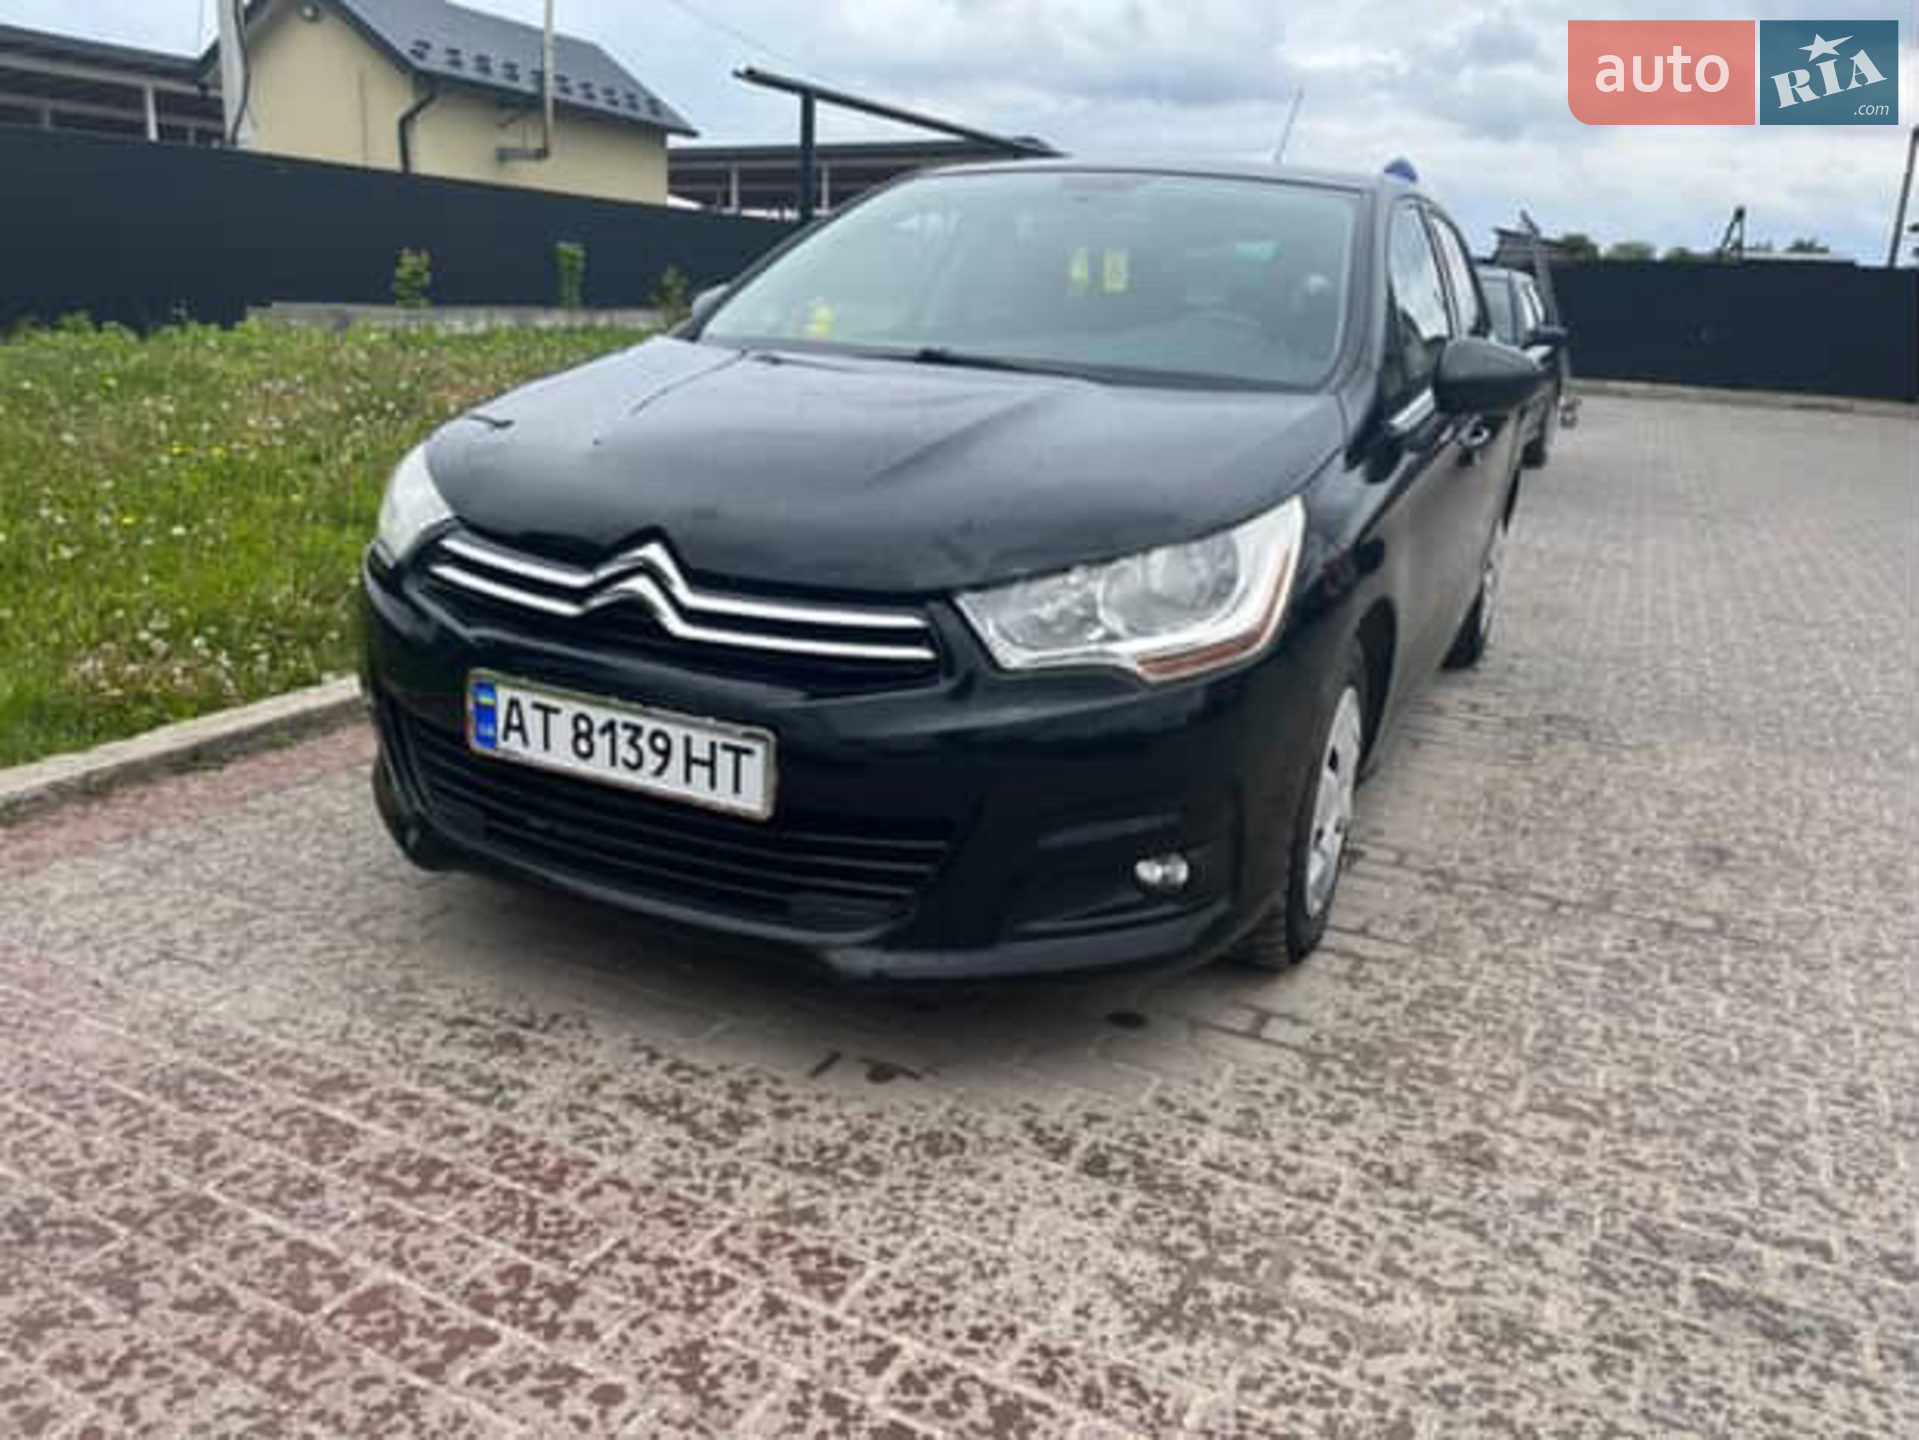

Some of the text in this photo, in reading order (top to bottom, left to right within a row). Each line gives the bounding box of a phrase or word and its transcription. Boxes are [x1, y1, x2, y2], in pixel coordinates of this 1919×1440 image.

[502, 697, 755, 795] AT 8139 HT
